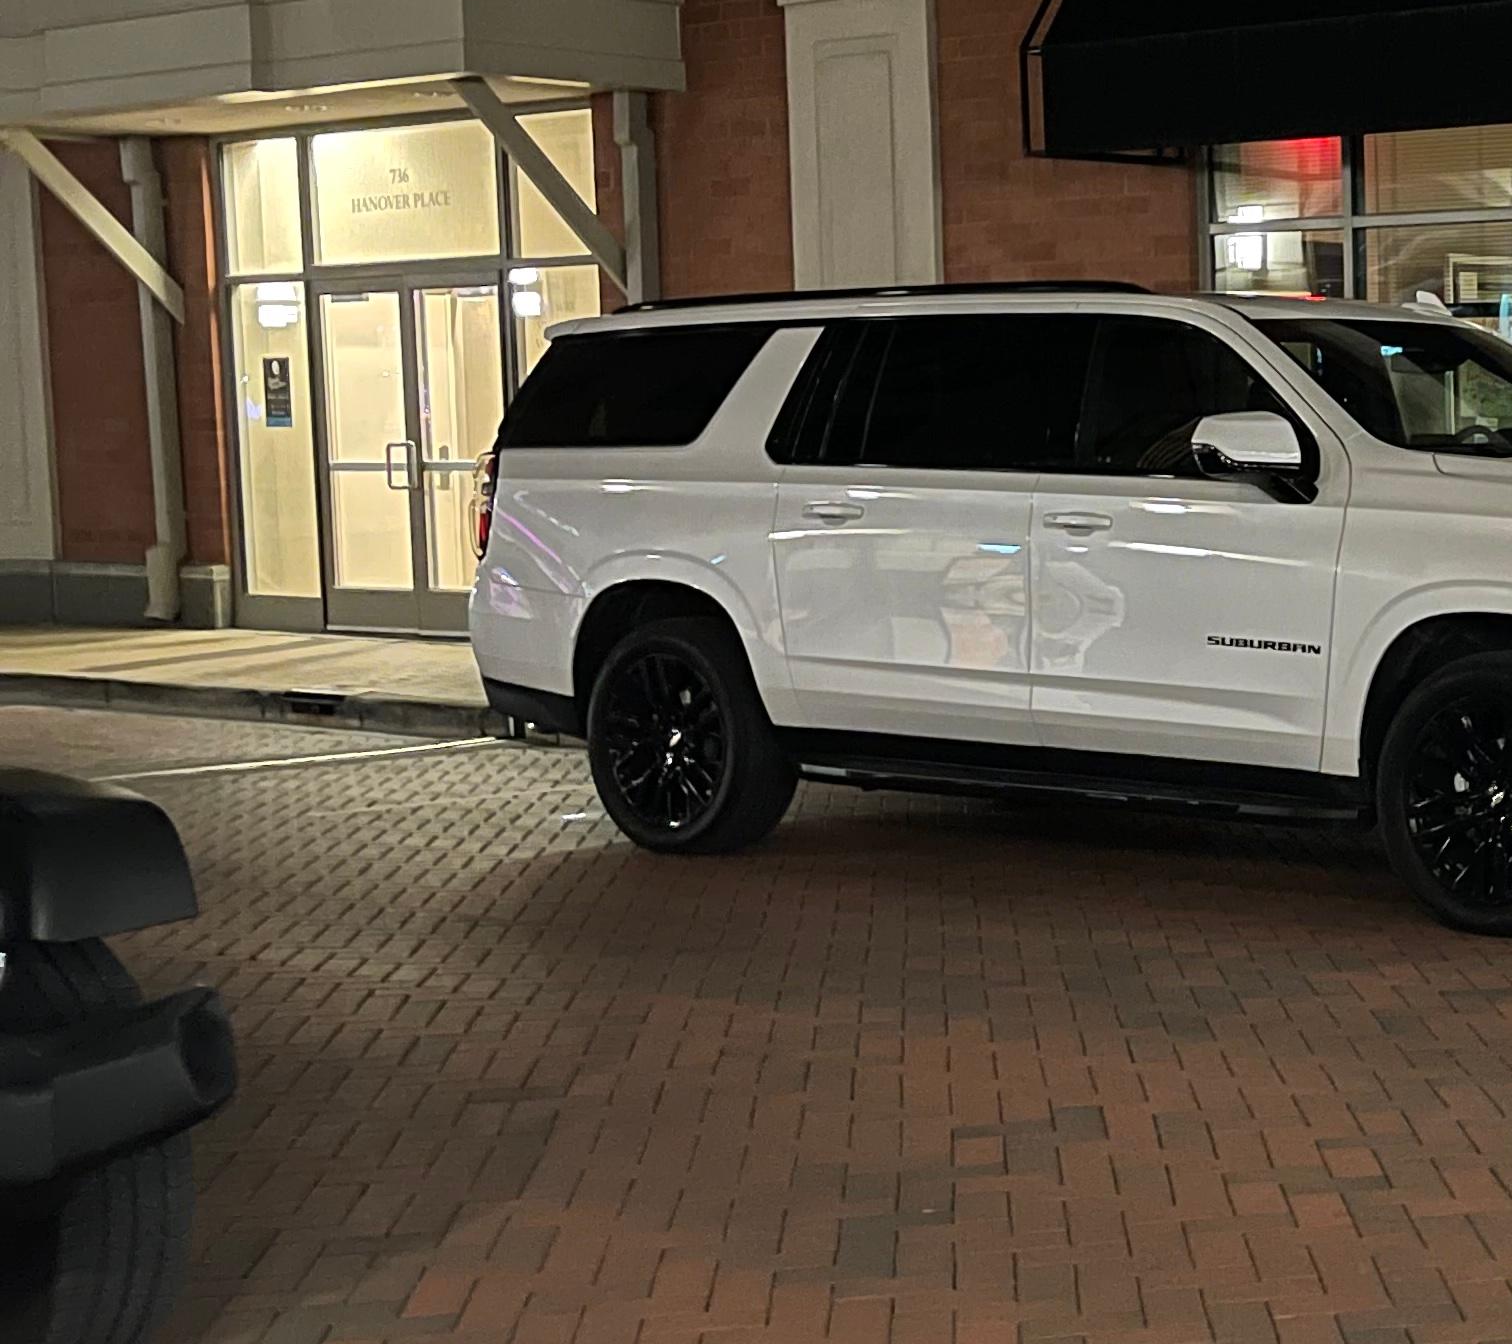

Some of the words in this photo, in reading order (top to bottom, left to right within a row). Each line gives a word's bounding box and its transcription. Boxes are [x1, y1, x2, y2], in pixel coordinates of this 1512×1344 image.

[388, 167, 410, 184] 736
[351, 193, 411, 214] HANOVER
[412, 190, 451, 209] PLACE
[1206, 635, 1322, 655] SUBURBAN
